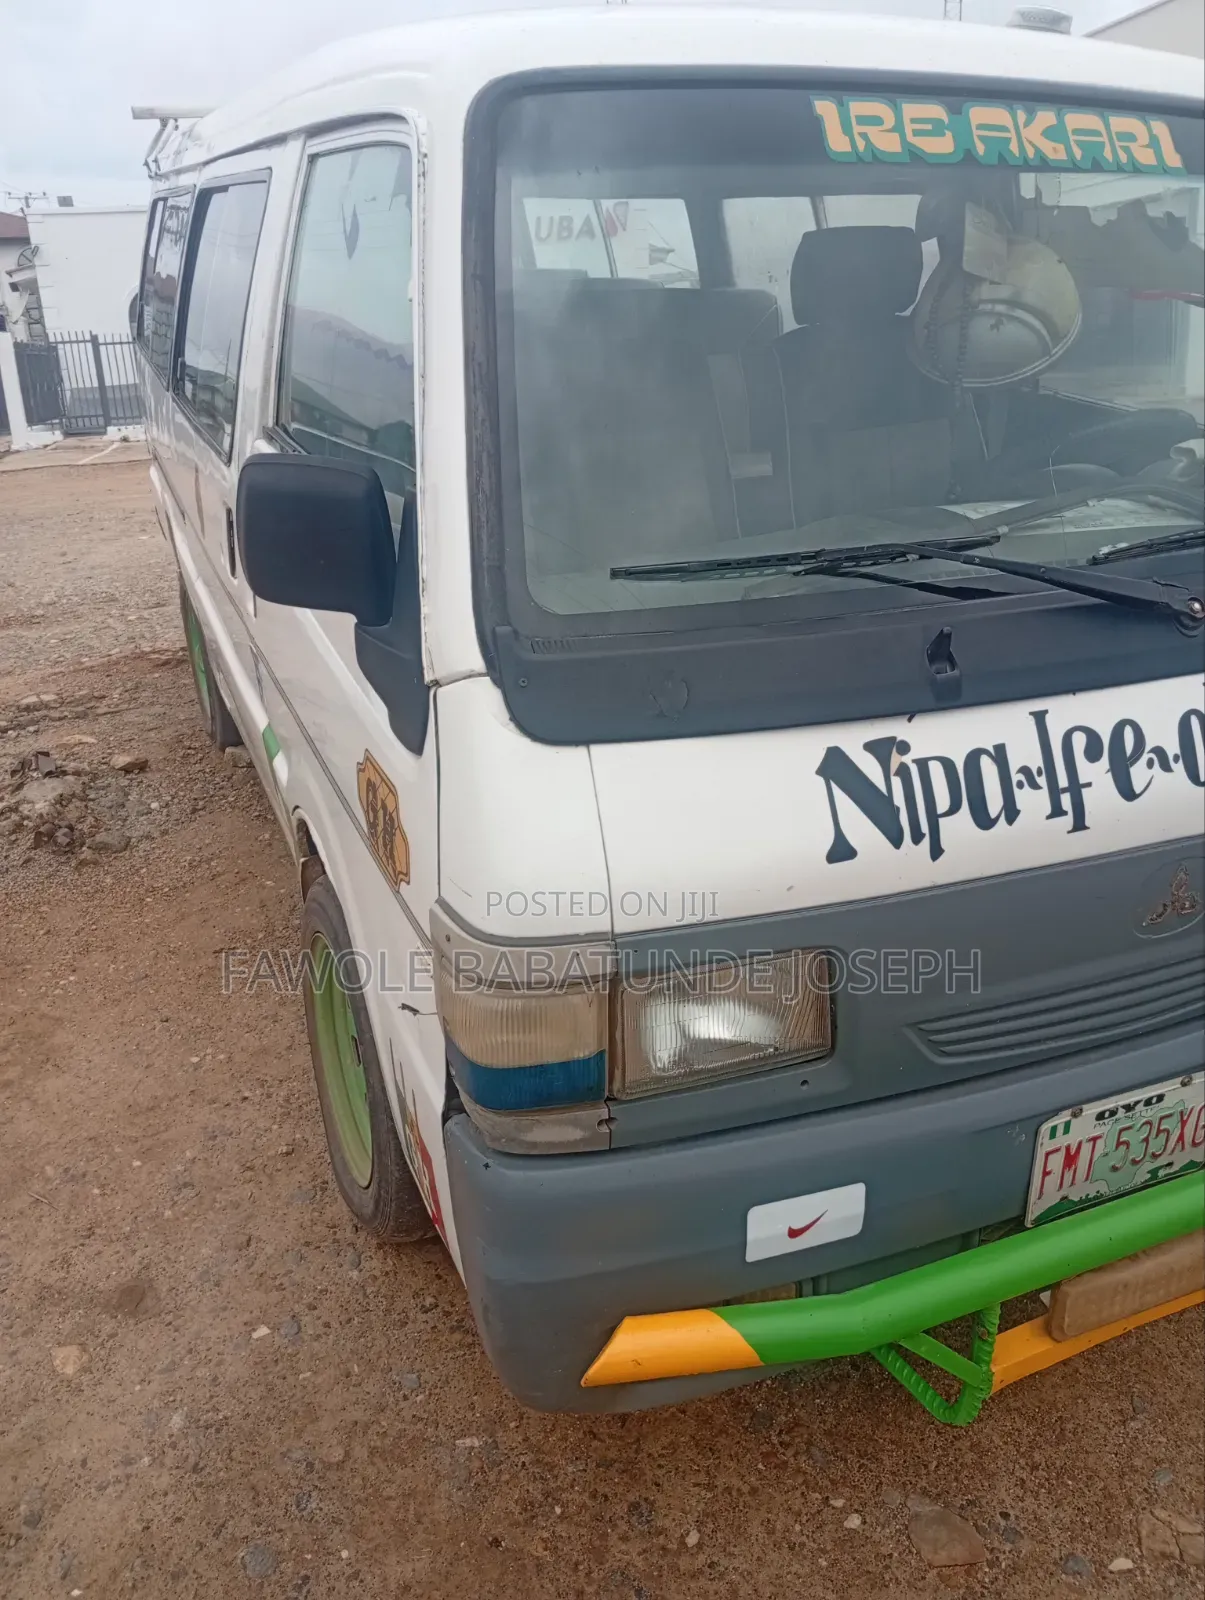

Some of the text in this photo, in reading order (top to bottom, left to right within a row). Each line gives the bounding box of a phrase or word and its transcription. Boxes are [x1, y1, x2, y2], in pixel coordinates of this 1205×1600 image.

[811, 97, 1187, 175] IRE AKARI
[535, 214, 597, 242] UBA
[1095, 1093, 1166, 1121] OYO
